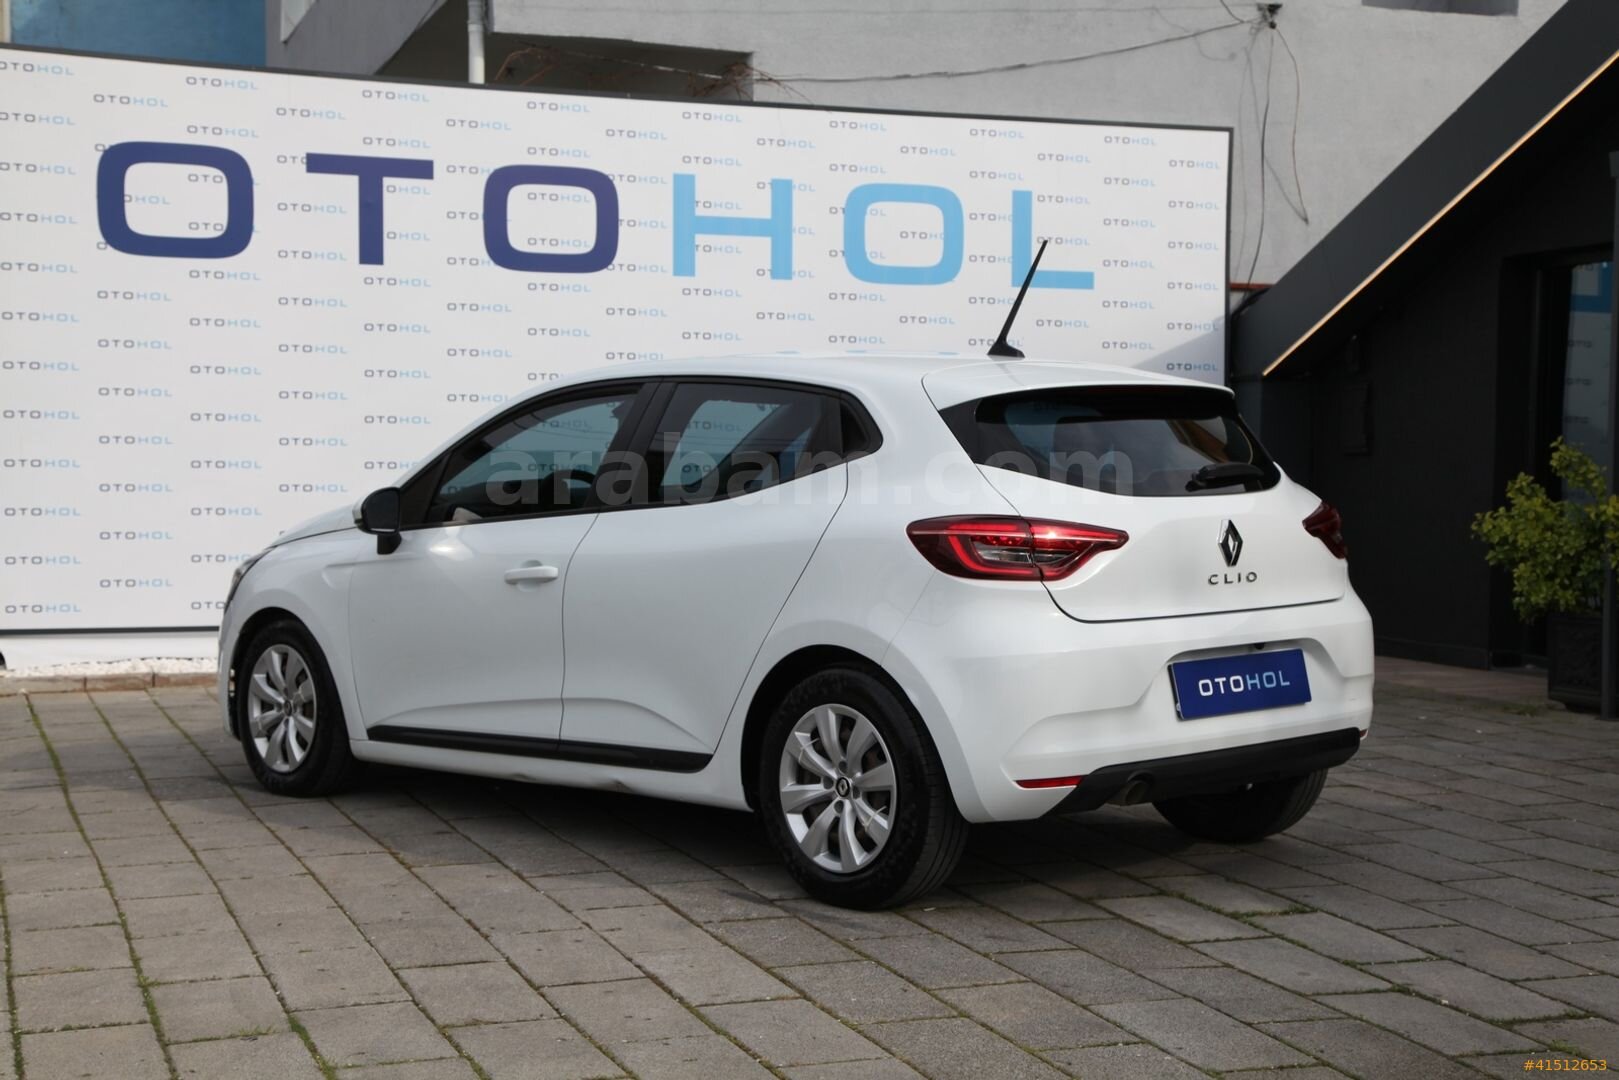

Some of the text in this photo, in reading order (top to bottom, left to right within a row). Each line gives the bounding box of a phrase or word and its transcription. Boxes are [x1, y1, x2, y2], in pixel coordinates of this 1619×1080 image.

[185, 74, 258, 90] OTOHOL
[92, 93, 168, 107] OTOHOL
[361, 88, 431, 103] OTOHOL
[526, 99, 591, 113] OTOHOL
[275, 107, 345, 120] OTOHOL
[682, 110, 743, 123] OTOHOL
[445, 118, 511, 131] OTOHOL
[829, 120, 887, 132] OTOHOL
[186, 125, 259, 138] OTOHOL
[605, 128, 667, 140] OTOHOL
[969, 128, 1024, 139] OTOHOL
[362, 136, 431, 149] OTOHOL
[756, 138, 816, 149] OTOHOL
[1104, 136, 1156, 146] OTOHOL
[526, 146, 590, 158] OTOHOL
[900, 145, 956, 156] OTOHOL
[681, 155, 742, 167] OTOHOL
[1037, 153, 1090, 163] OTOHOL
[829, 163, 886, 174] OTOHOL
[1168, 159, 1220, 170] OTOHOL
[969, 170, 1023, 181] OTOHOL
[1103, 177, 1155, 187] OTOHOL
[386, 185, 431, 196] OHOL
[527, 192, 592, 203] OTOHOL
[1037, 194, 1090, 205] OTOHOL
[277, 202, 347, 214] OTOHOL
[695, 200, 743, 211] TOHOL
[1168, 200, 1219, 210] OTOHOL
[0, 211, 77, 224] OTOHOL
[97, 141, 1094, 290] OTOHOL
[618, 218, 668, 229] TOHOL
[1103, 218, 1156, 228] OTOHOL
[386, 230, 431, 241] OHOL
[527, 237, 592, 248] OTOHOL
[1167, 241, 1219, 251] OTOHOL
[695, 244, 743, 255] TOHOL
[277, 249, 347, 262] OTOHOL
[0, 261, 76, 273] OTOHOL
[1102, 259, 1154, 269] OTOHOL
[188, 269, 260, 281] OTOHOL
[363, 276, 431, 287] OTOHOL
[1167, 281, 1219, 291] OTOHOL
[527, 282, 591, 293] OTOHOL
[682, 288, 742, 298] OTOHOL
[96, 290, 171, 302] OTOHOL
[828, 292, 886, 303] OTOHOL
[278, 296, 348, 308] OTOHOL
[446, 302, 512, 313] OTOHOL
[1102, 300, 1154, 310] OTOHOL
[0, 311, 79, 323] OTOHOL
[605, 307, 667, 317] OTOHOL
[756, 312, 815, 321] OTOHOL
[189, 317, 261, 328] OTOHOL
[899, 315, 955, 325] OTOHOL
[1035, 319, 1089, 328] OTOHOL
[363, 322, 430, 334] OTOHOL
[527, 327, 591, 337] OTOHOL
[681, 331, 742, 341] OTOHOL
[828, 335, 885, 344] OTOHOL
[97, 338, 171, 349] OTOHOL
[278, 344, 348, 354] OTOHOL
[1101, 341, 1154, 351] OTOHOL
[446, 348, 512, 358] OTOHOL
[2, 360, 79, 371] OTOHOL
[189, 365, 261, 376] OTOHOL
[1166, 362, 1218, 371] OTOHOL
[364, 369, 431, 379] OTOHOL
[98, 387, 172, 397] OTOHOL
[278, 390, 348, 400] OTOHOL
[2, 409, 80, 420] OTOHOL
[190, 412, 261, 422] OTOHOL
[364, 415, 431, 425] OTOHOL
[98, 435, 173, 445] OTOHOL
[278, 436, 348, 447] OTOHOL
[3, 458, 80, 468] OTOHOL
[190, 460, 262, 469] OTOHOL
[98, 483, 172, 493] OTOHOL
[278, 483, 348, 493] OTOHOL
[3, 507, 80, 517] OTOHOL
[190, 507, 262, 516] OTOHOL
[99, 531, 173, 541] OTOHOL
[4, 555, 81, 566] OTOHOL
[99, 578, 172, 588] OTOHOL
[1208, 572, 1258, 585] CLIO
[3, 603, 81, 614] OTOHOL
[1198, 671, 1291, 697] OTOHOL
